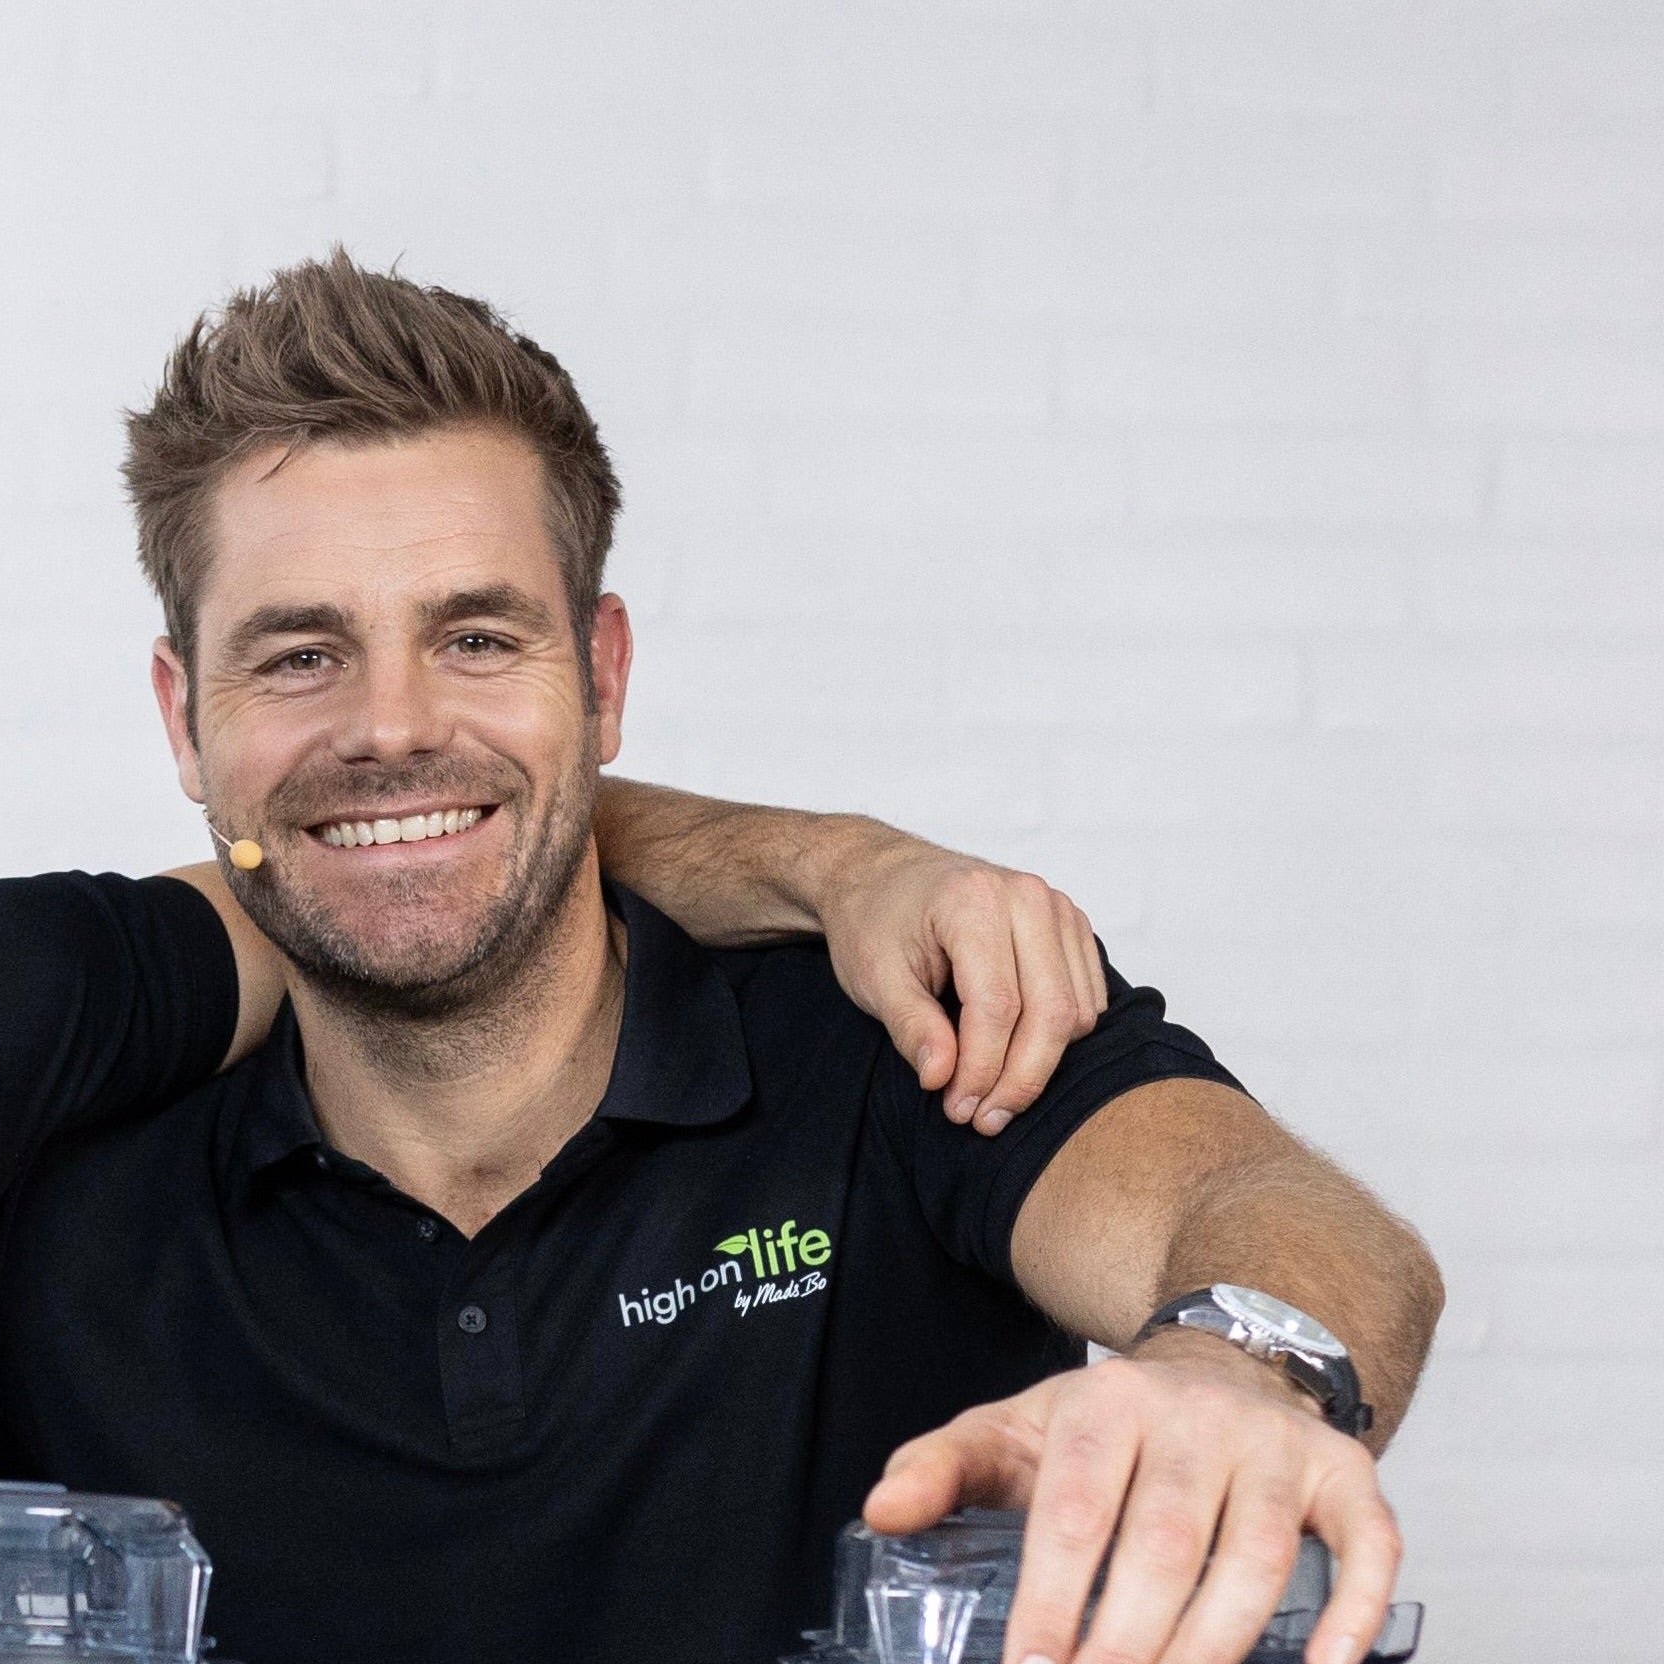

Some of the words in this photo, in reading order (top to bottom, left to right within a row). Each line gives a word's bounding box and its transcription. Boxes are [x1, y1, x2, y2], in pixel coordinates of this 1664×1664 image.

[618, 1278, 696, 1327] high
[700, 1260, 743, 1292] on
[748, 1219, 832, 1278] life
[734, 1289, 752, 1317] by
[753, 1280, 800, 1308] Mads
[799, 1271, 828, 1298] Bo
